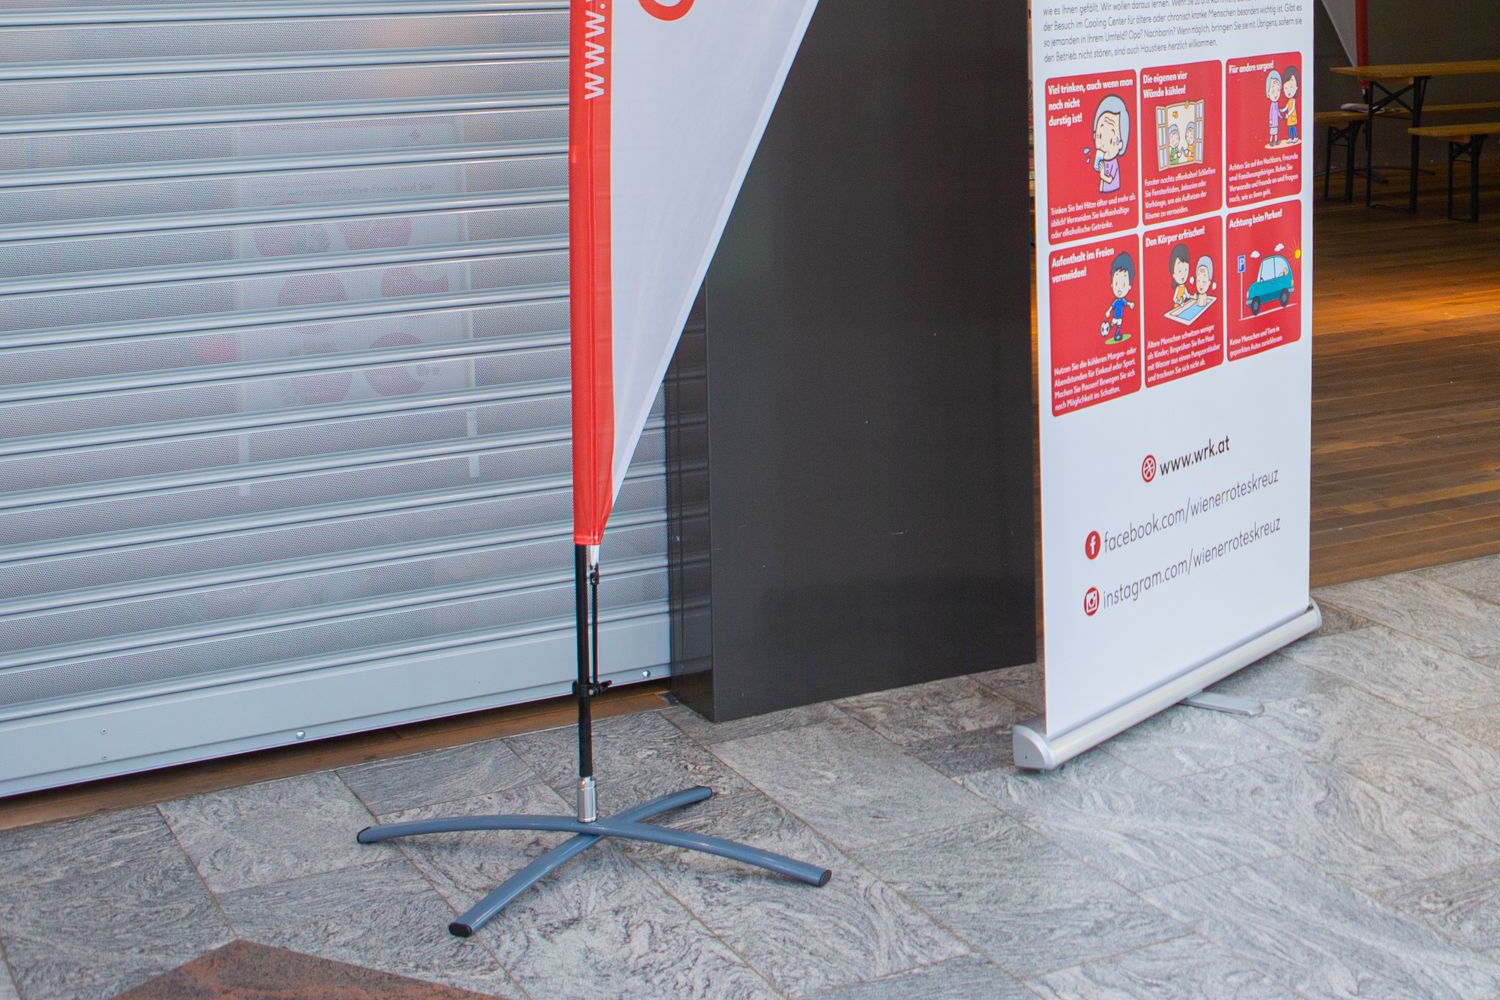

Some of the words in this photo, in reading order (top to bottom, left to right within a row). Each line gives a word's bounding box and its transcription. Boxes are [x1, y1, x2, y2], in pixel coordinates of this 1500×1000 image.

[1084, 17, 1106, 30] Cooling
[1048, 84, 1060, 95] Viel
[1087, 80, 1102, 91] auch
[1048, 99, 1064, 110] noch
[1064, 98, 1080, 108] nicht
[1160, 435, 1230, 476] www.wrk.at
[1104, 469, 1278, 553] facebook.com/wienerroteskreuz
[1103, 517, 1280, 609] instagram.com/wienerroteskreuz
